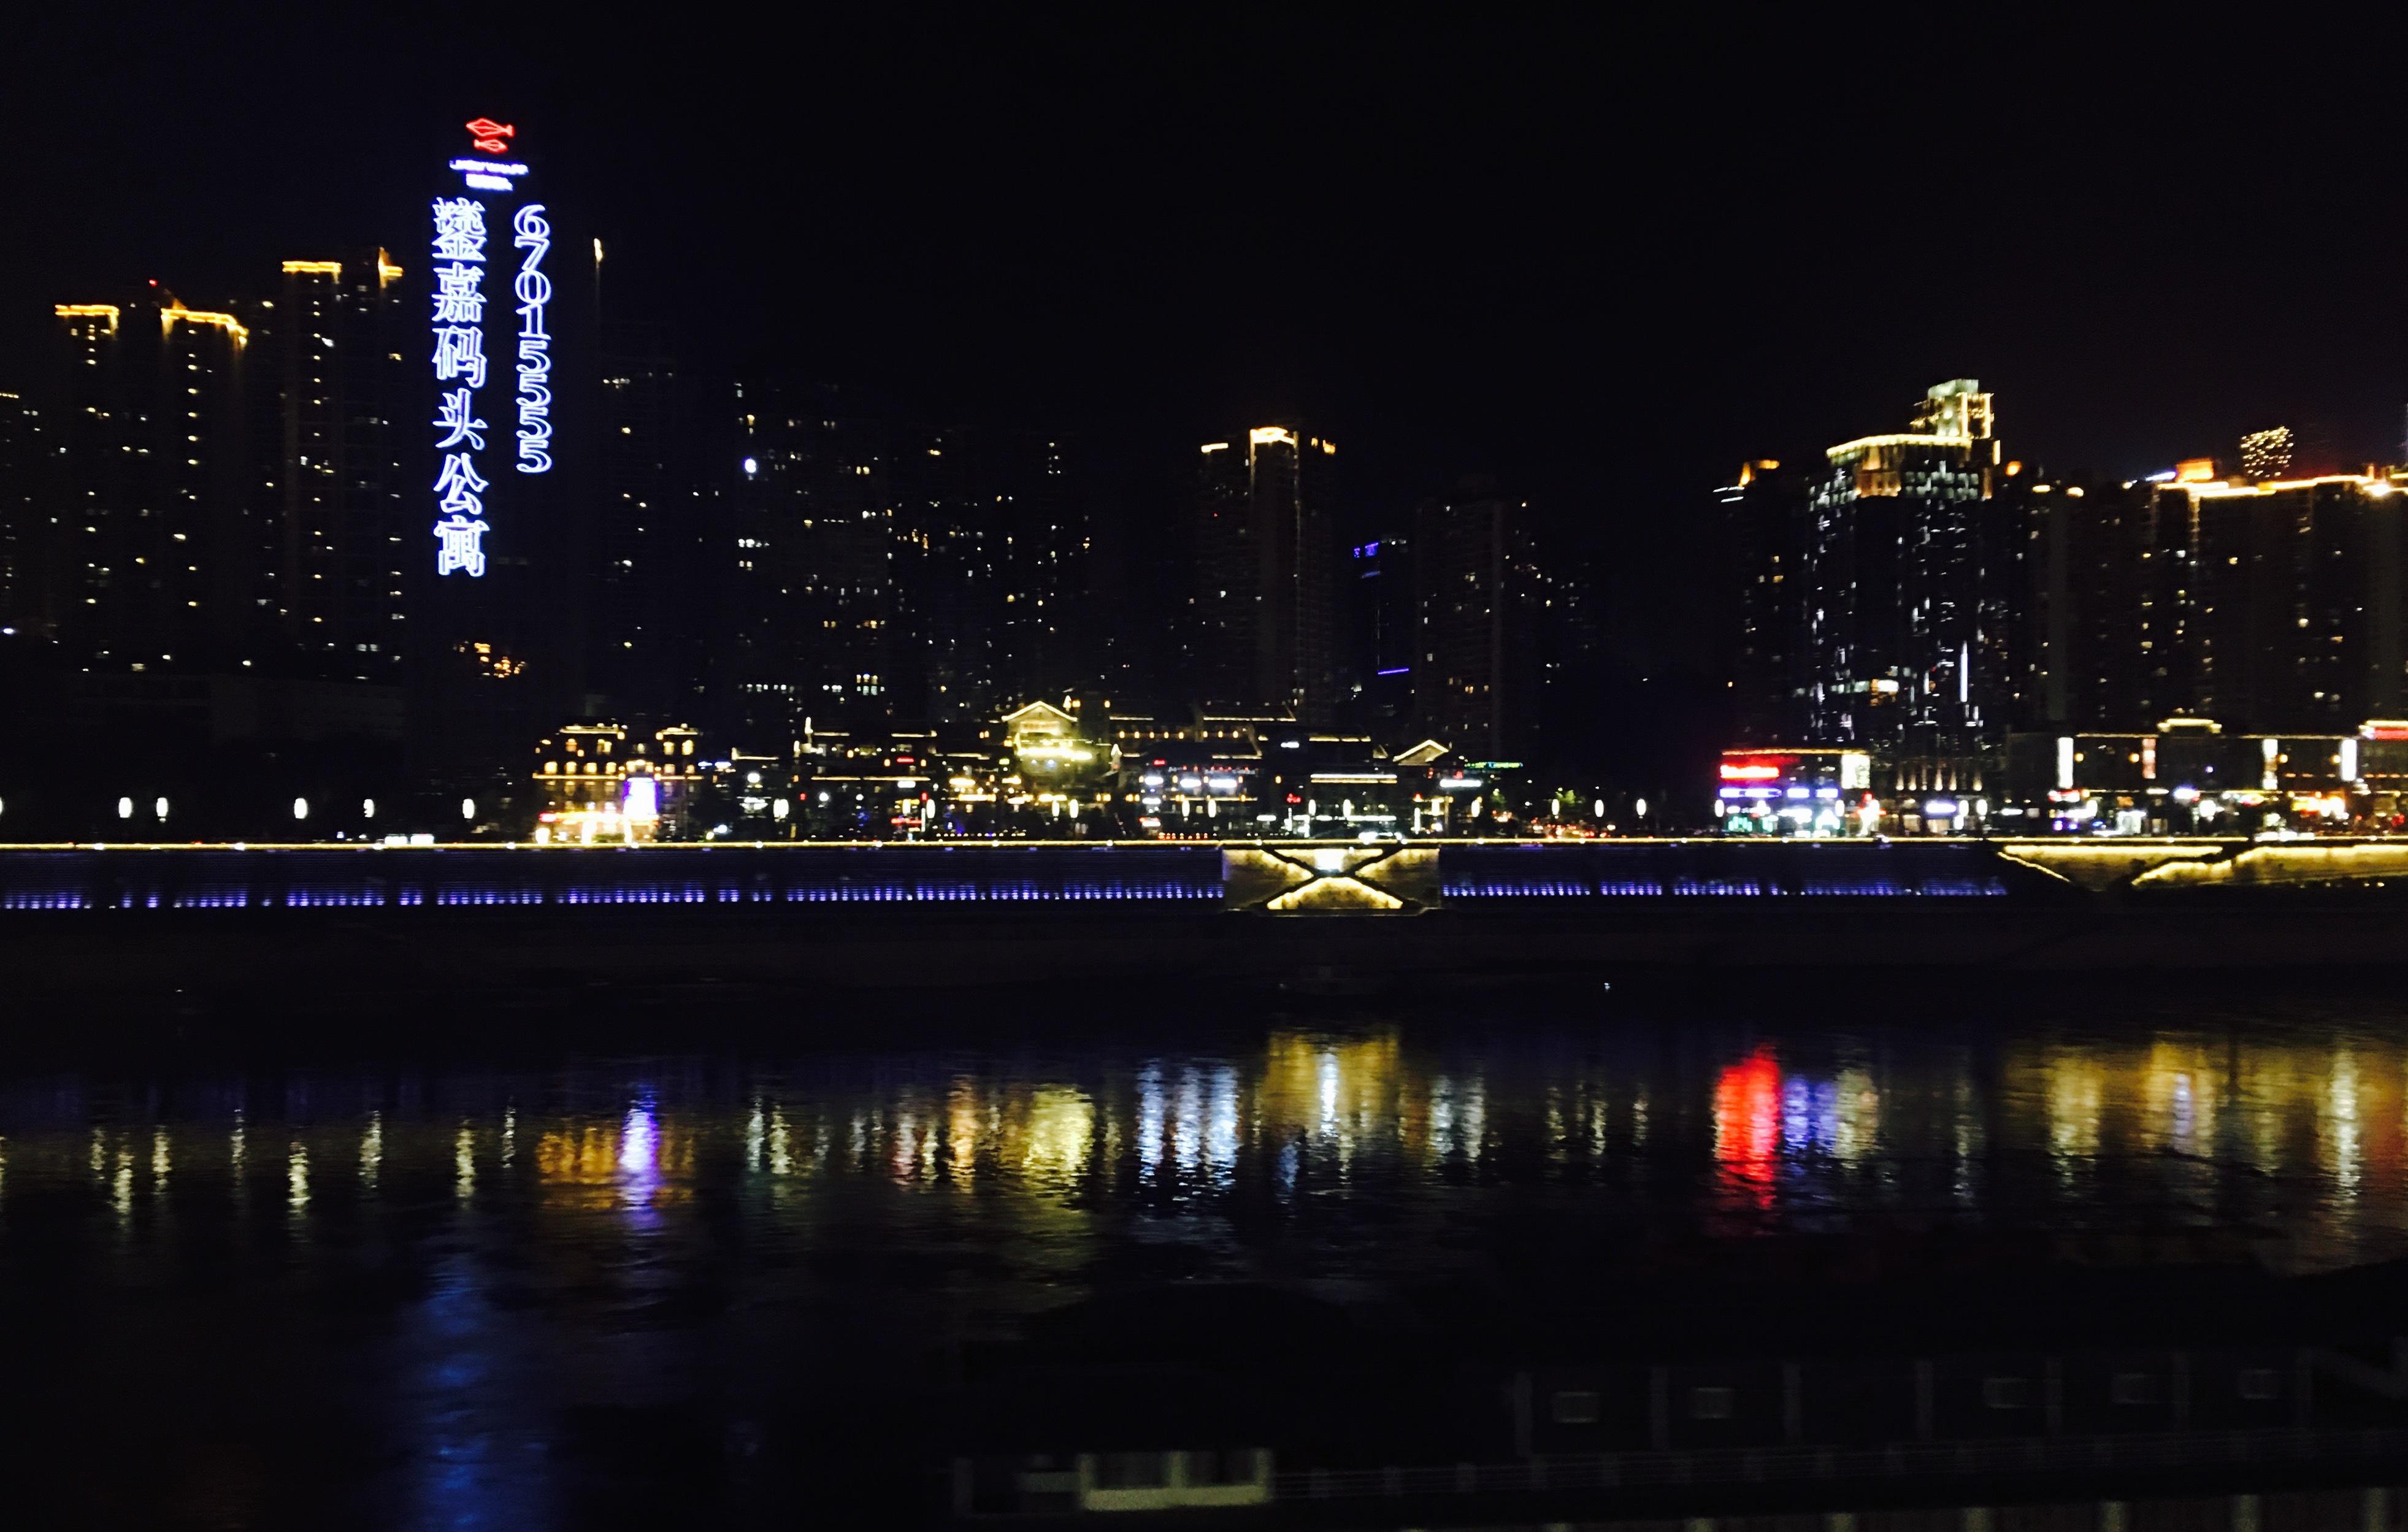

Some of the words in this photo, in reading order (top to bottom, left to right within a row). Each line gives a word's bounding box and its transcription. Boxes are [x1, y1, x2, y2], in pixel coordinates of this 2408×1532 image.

[431, 196, 490, 577] 鎏嘉码头公寓
[513, 204, 552, 473] 67015555
